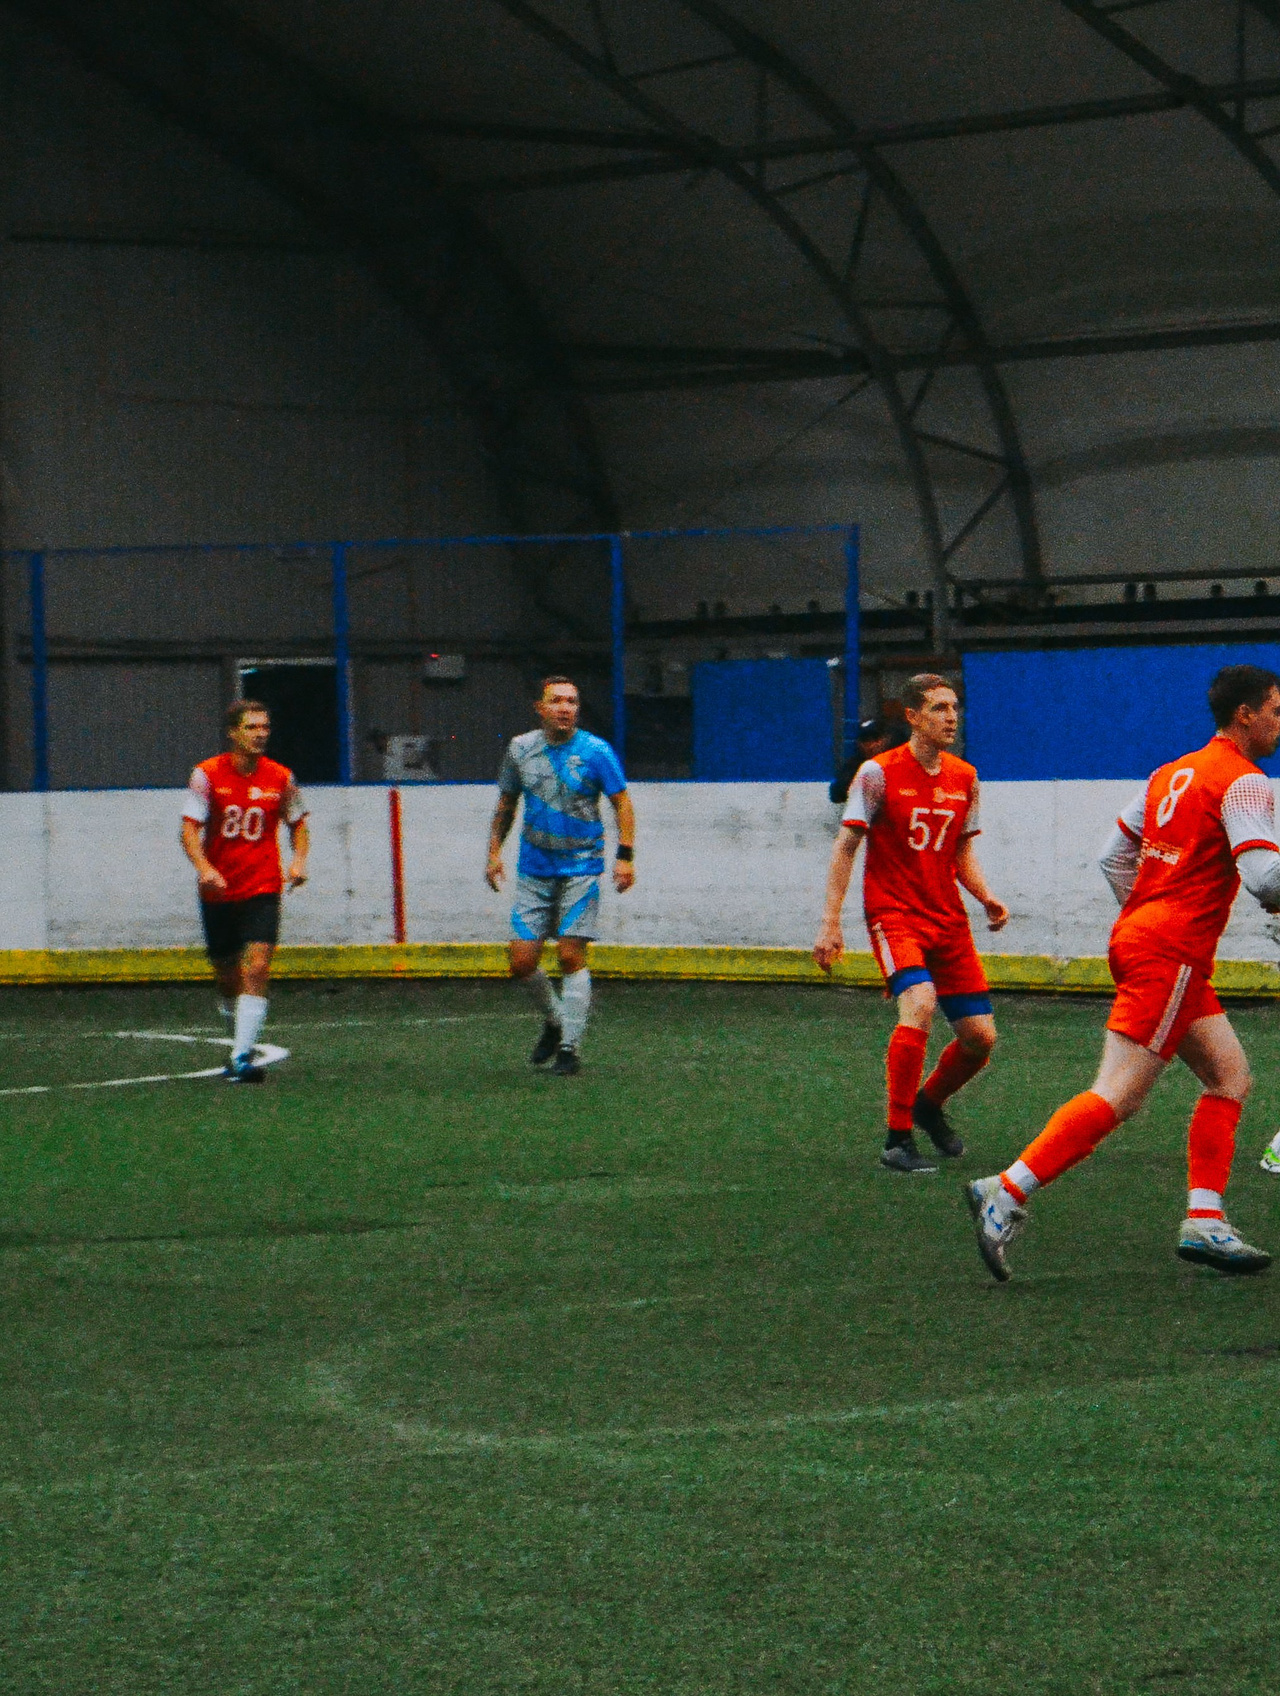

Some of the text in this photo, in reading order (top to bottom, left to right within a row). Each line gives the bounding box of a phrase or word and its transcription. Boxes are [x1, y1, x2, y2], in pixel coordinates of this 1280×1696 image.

[1157, 767, 1195, 828] 8
[221, 804, 265, 841] 80
[908, 807, 956, 852] 57
